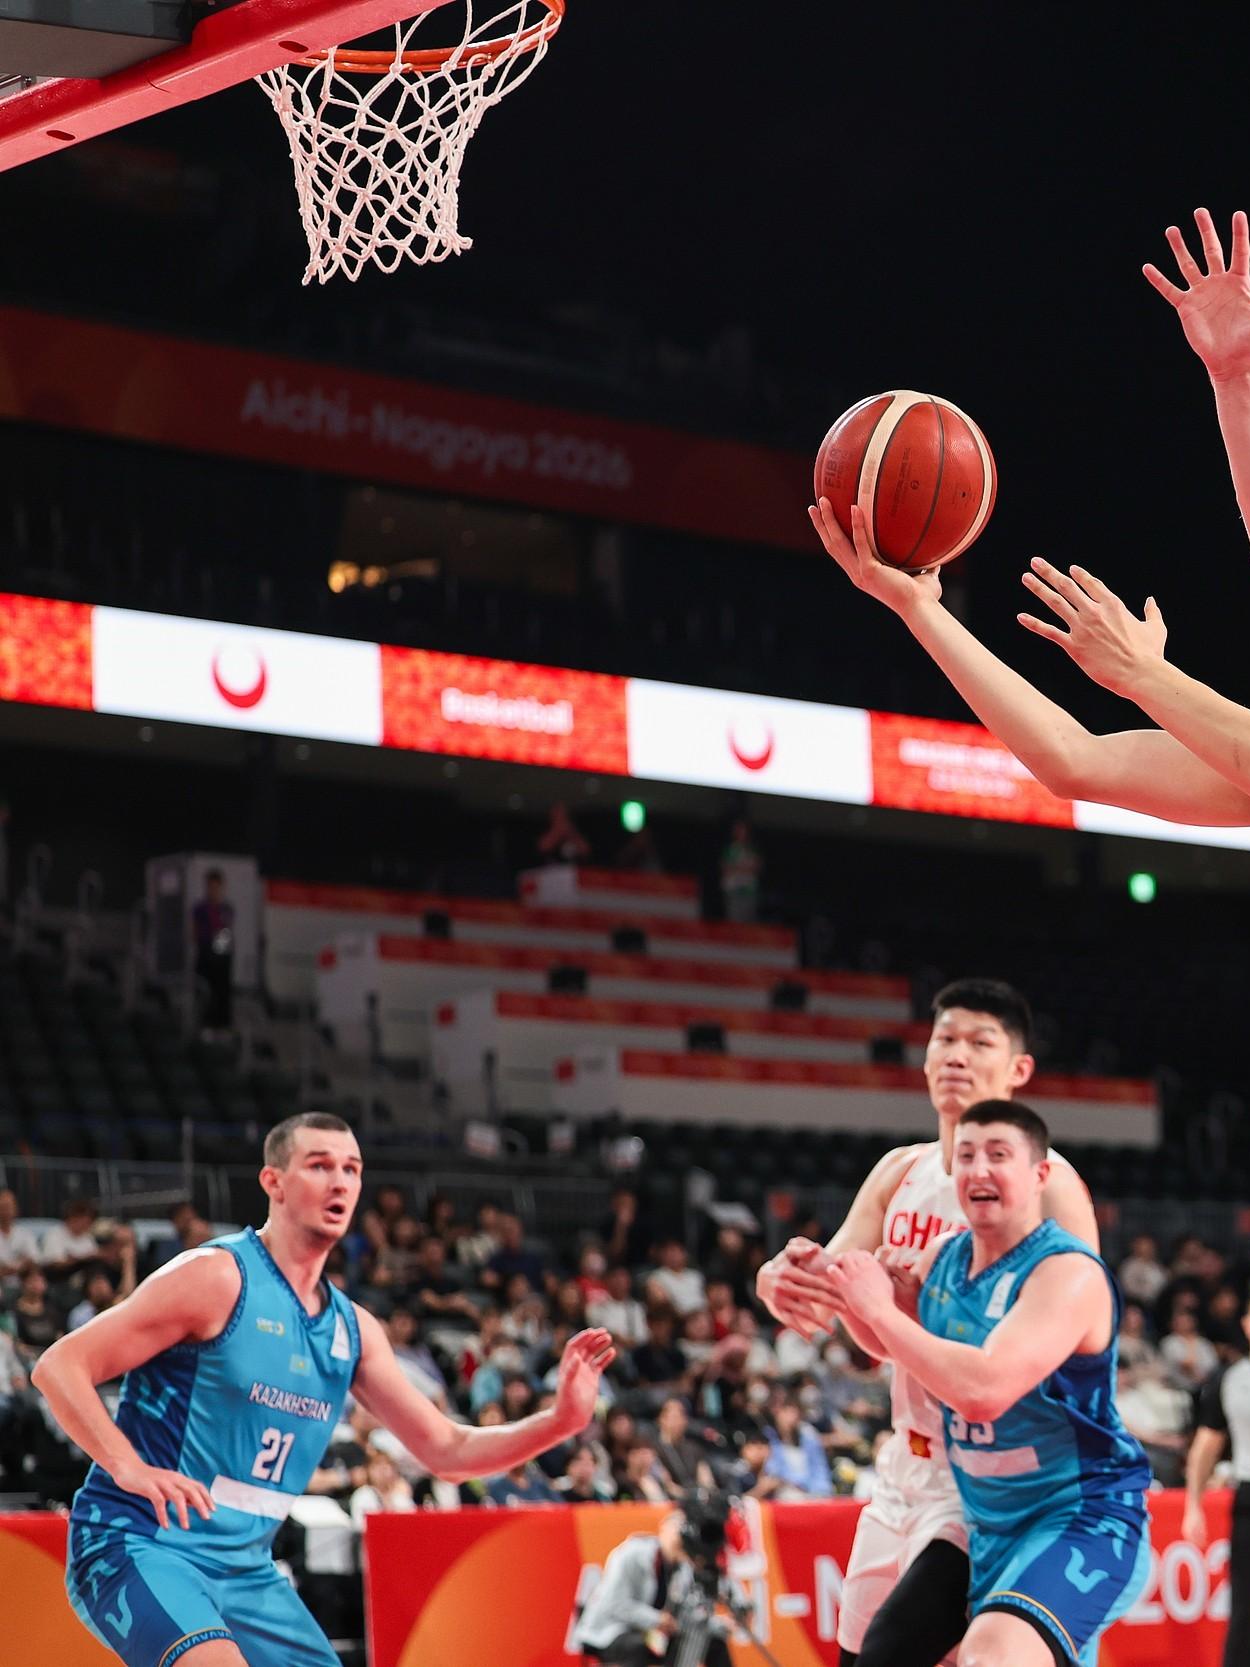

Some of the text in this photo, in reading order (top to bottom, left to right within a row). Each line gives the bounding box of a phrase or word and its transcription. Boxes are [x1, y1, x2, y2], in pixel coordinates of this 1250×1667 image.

[533, 431, 633, 489] 2026
[249, 1381, 332, 1423] KAZAKHSTAN
[251, 1427, 295, 1484] 21
